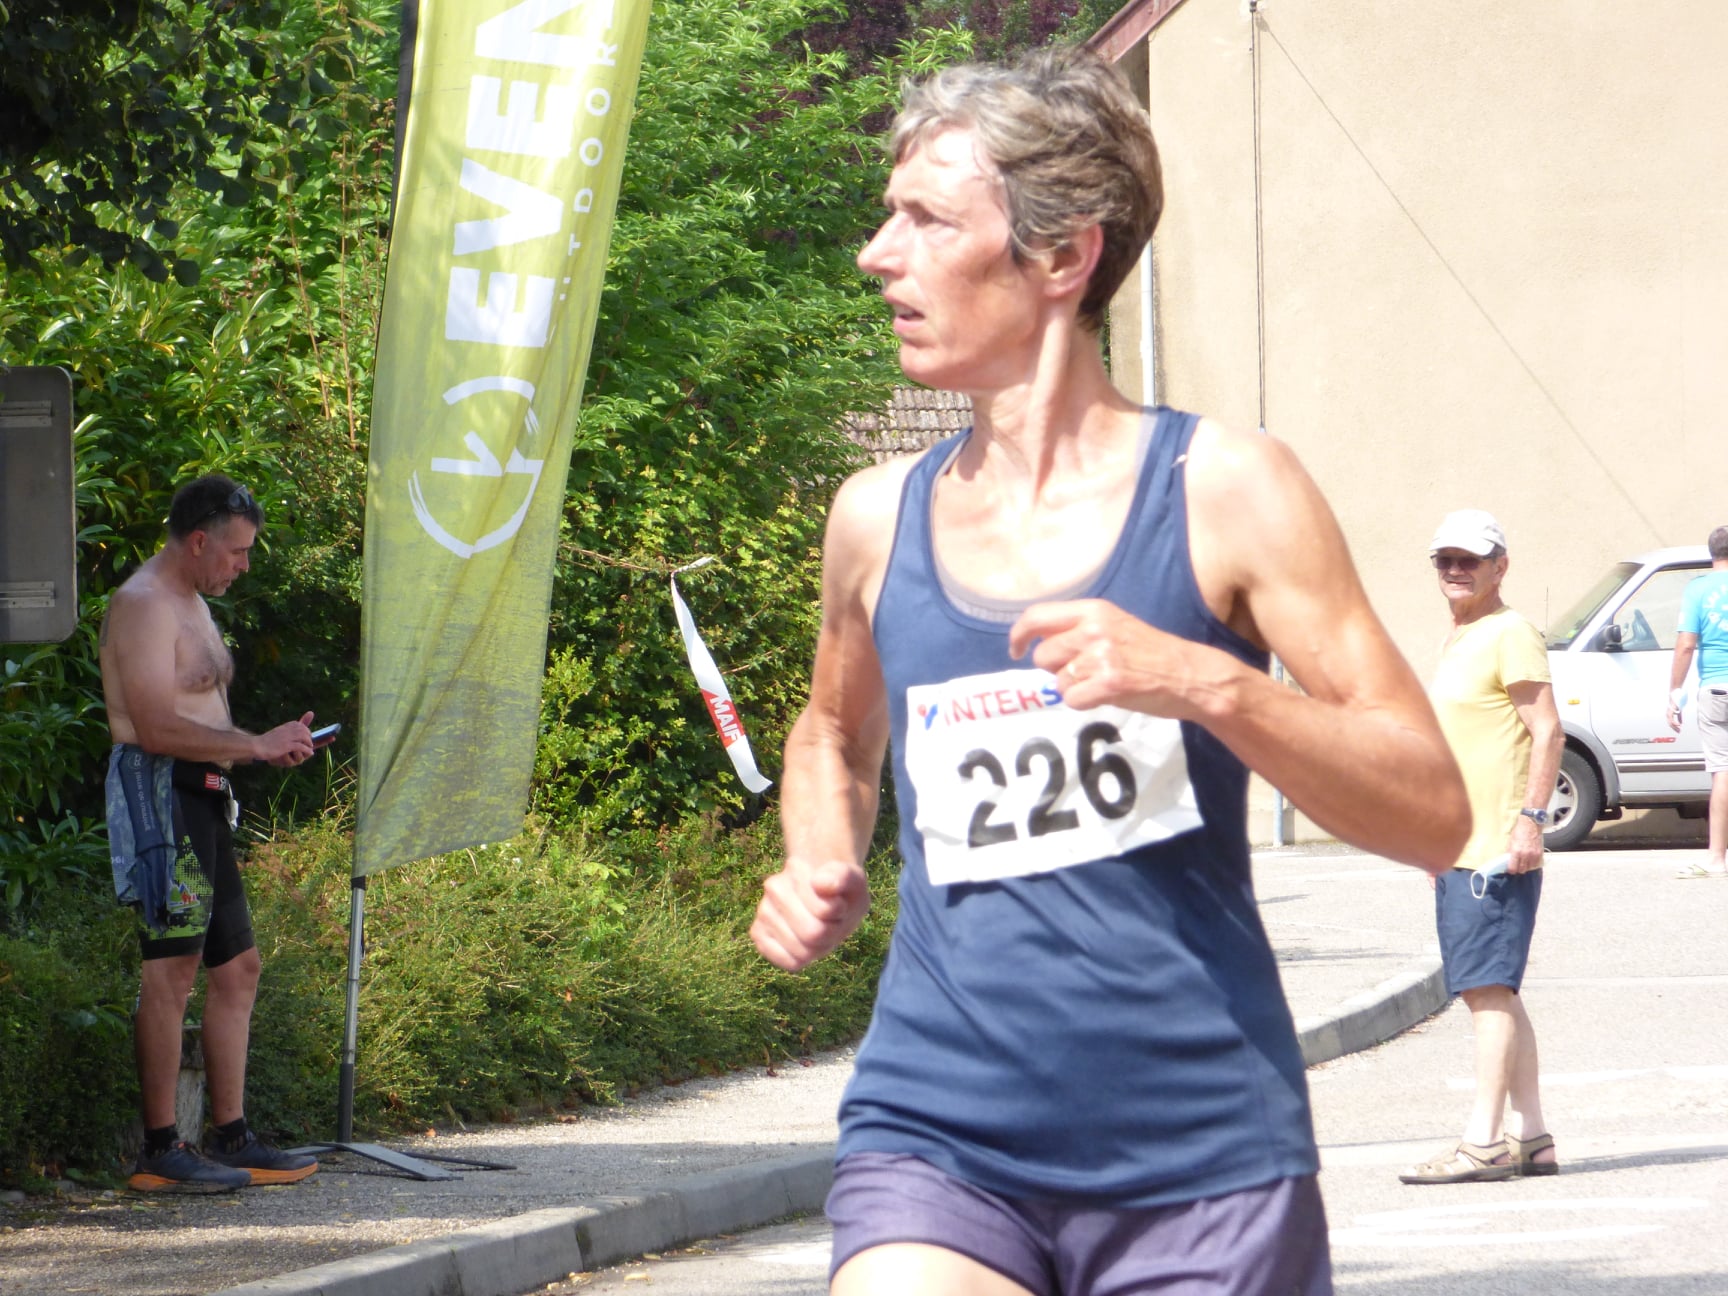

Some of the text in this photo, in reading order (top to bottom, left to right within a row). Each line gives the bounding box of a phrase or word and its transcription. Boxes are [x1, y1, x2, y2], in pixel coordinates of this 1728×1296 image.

[709, 695, 742, 741] MAIF
[944, 684, 1065, 727] INTERS
[957, 720, 1138, 849] 226
